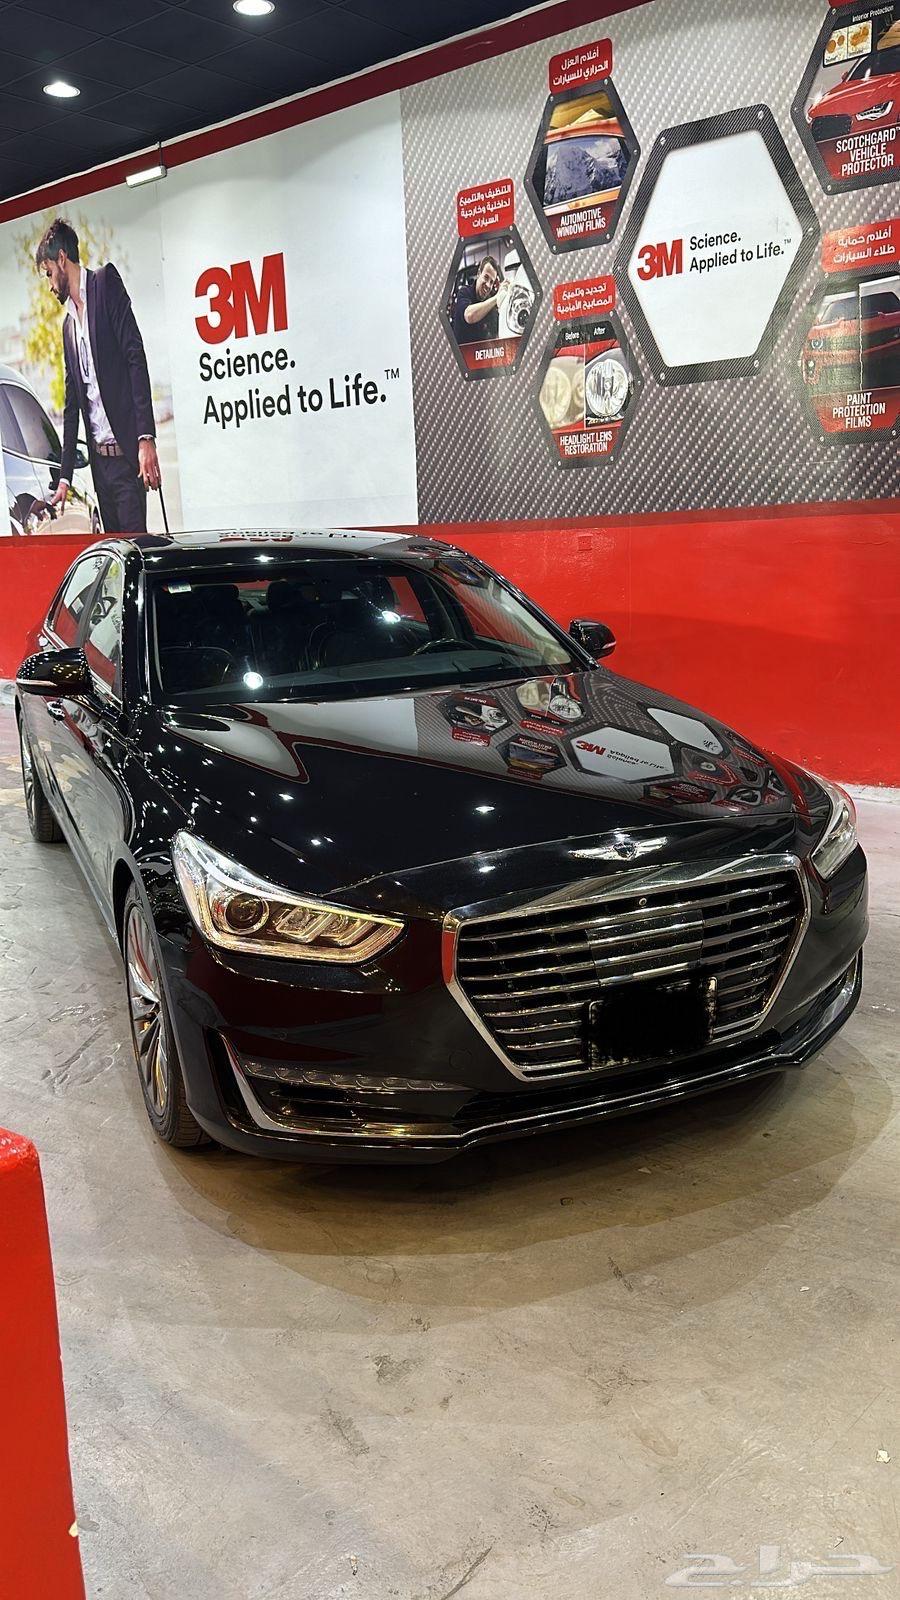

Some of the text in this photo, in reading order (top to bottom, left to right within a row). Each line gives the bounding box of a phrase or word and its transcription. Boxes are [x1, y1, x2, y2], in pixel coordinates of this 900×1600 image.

[852, 5, 894, 22] Interior Protection
[561, 46, 599, 71] أفلام العزل
[552, 60, 609, 86] الحراري للسيارات
[850, 142, 887, 162] VEHICLE
[841, 153, 894, 177] PROTECTOR
[484, 184, 511, 199] التنظيف
[472, 214, 499, 227] السيارات
[560, 207, 602, 225] AUTOMOTIVE
[556, 217, 606, 238] WINDOW FILMS
[866, 224, 892, 244] أفلام
[689, 231, 742, 251] Science.
[637, 238, 683, 281] 3M
[689, 248, 738, 274] Applied
[741, 249, 754, 263] to
[833, 243, 896, 264] طلاء السيارات
[194, 252, 288, 344] 3M
[585, 282, 607, 295] تجديد
[583, 295, 613, 310] المصابيح
[475, 347, 505, 361] DETAILING
[199, 348, 295, 381] Science.
[203, 384, 292, 429] Applied
[297, 385, 323, 412] to
[846, 391, 872, 405] PAINT
[832, 402, 886, 418] PROTECTION
[845, 415, 872, 429] FILMS
[560, 430, 613, 446] HEADLIGHT LENS
[564, 441, 608, 455] RESTORATION
